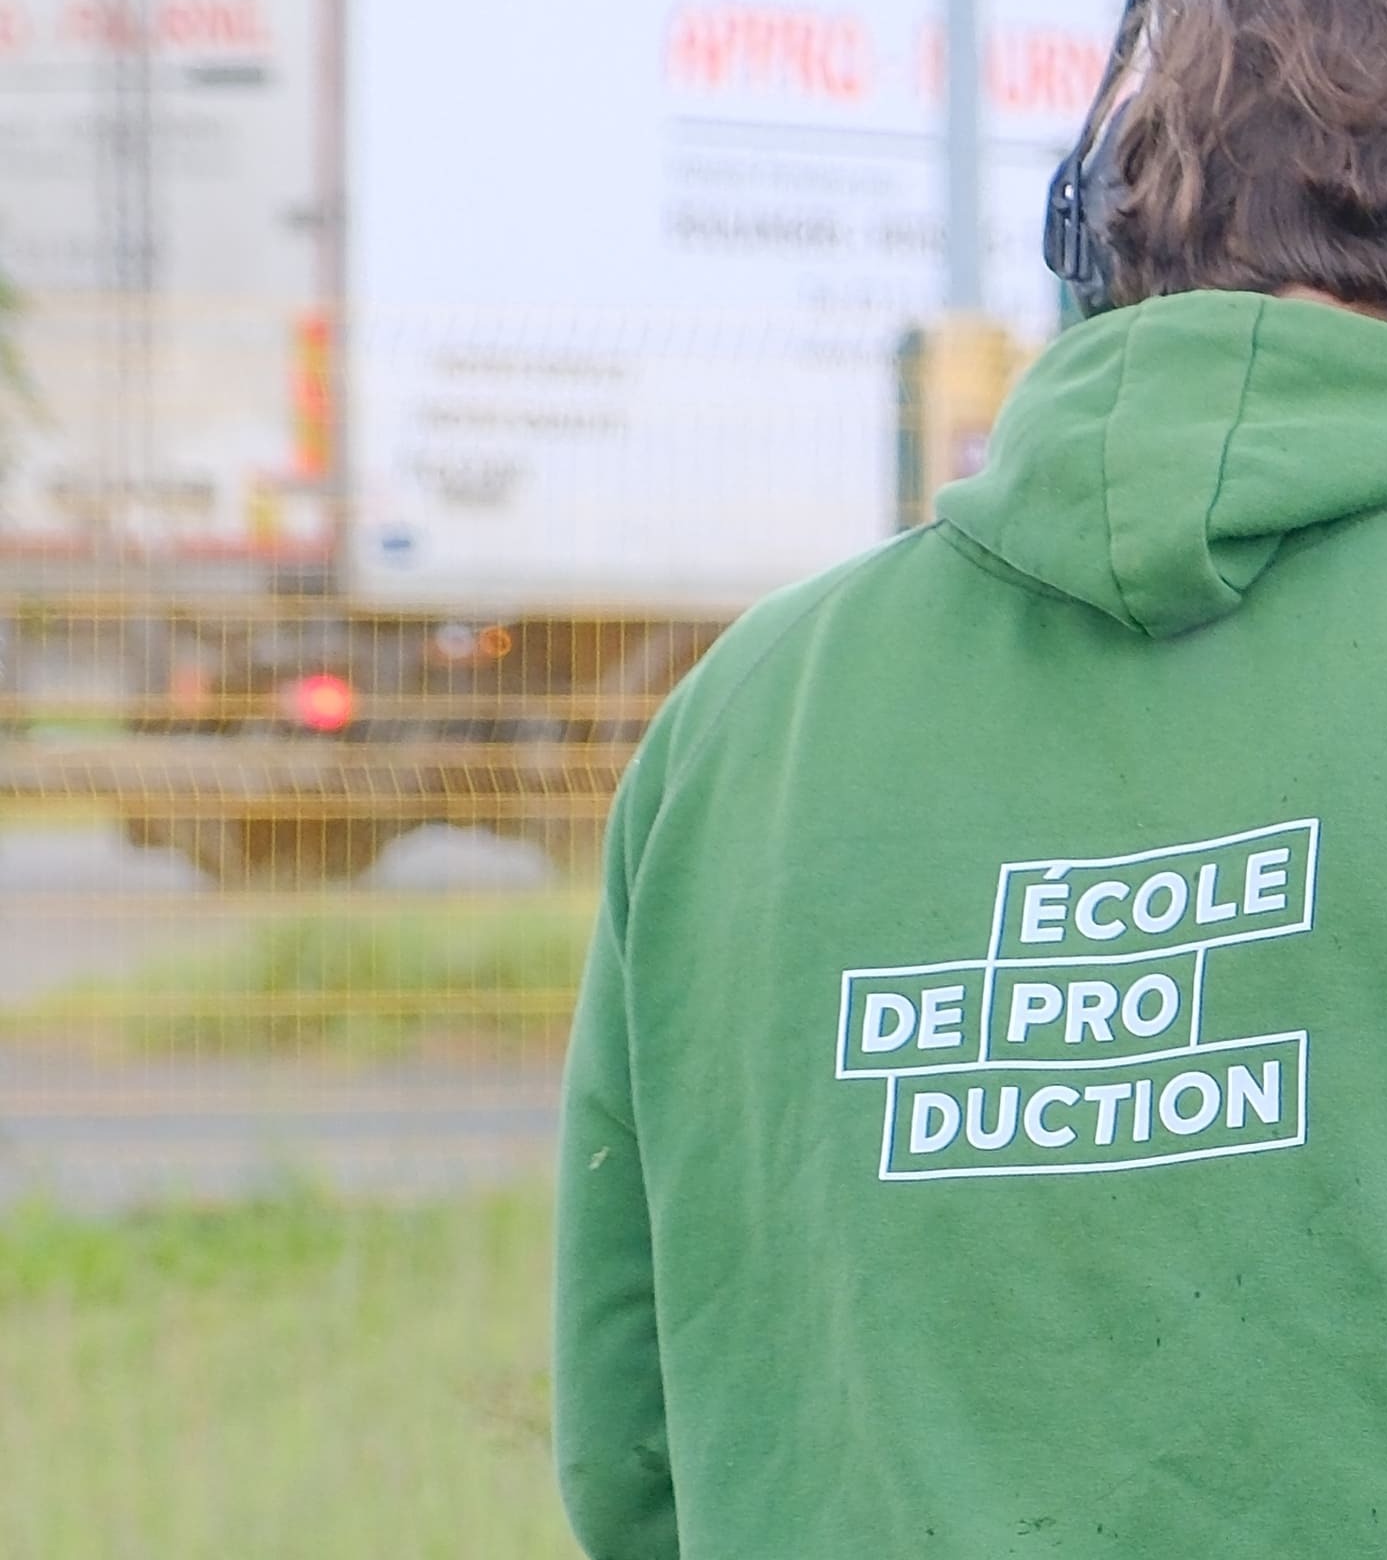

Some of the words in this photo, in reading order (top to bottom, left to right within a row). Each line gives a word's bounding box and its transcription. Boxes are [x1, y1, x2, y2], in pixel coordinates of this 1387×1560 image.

[1020, 848, 1290, 944] ÉCOLE
[860, 985, 966, 1053] DE
[1006, 973, 1181, 1044] PRO
[909, 1060, 1281, 1155] DUCTION
